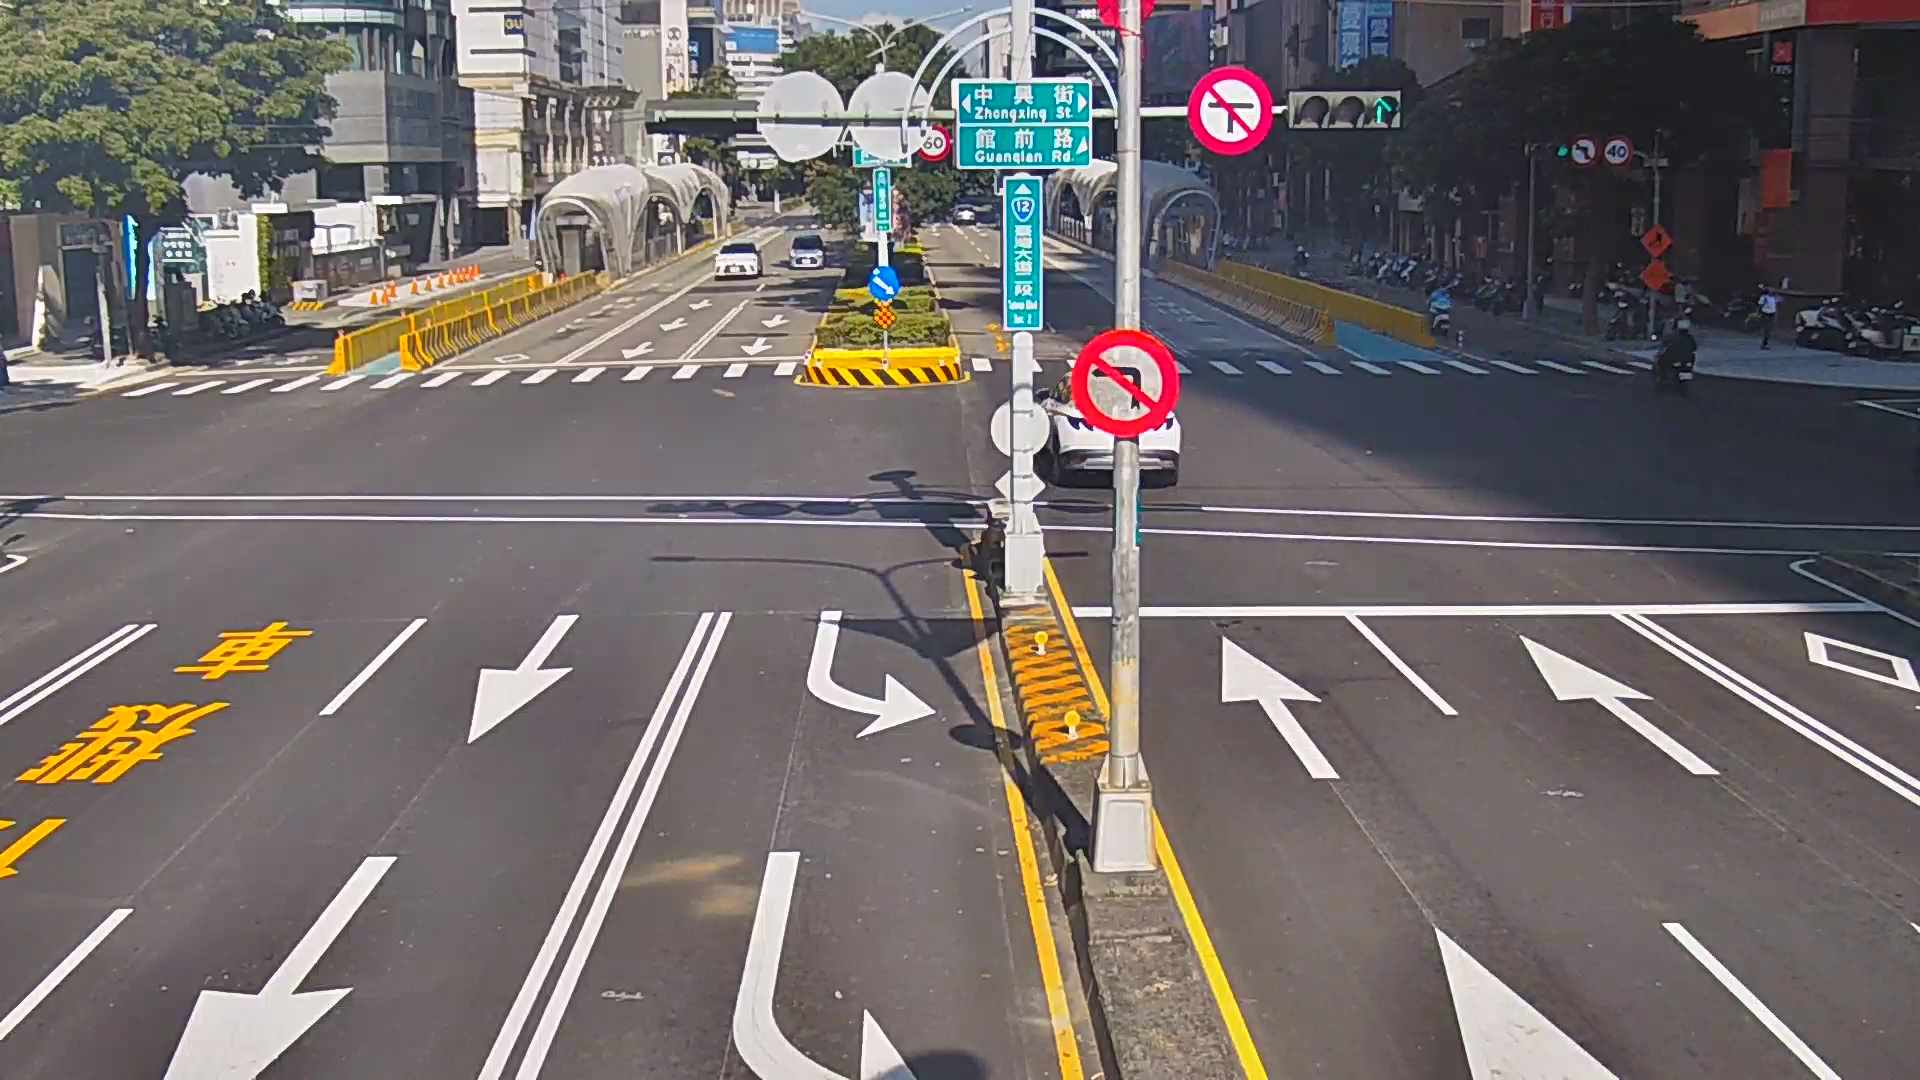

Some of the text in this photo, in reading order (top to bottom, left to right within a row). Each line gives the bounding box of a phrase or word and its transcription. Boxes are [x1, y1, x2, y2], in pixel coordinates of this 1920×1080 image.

[974, 84, 1074, 105] 中興街
[974, 106, 1047, 124] Zhongxing
[923, 136, 944, 149] 60
[975, 128, 1074, 149] 館前路
[974, 150, 1043, 164] Guanqian
[1607, 145, 1626, 158] 40
[1016, 200, 1030, 213] 12
